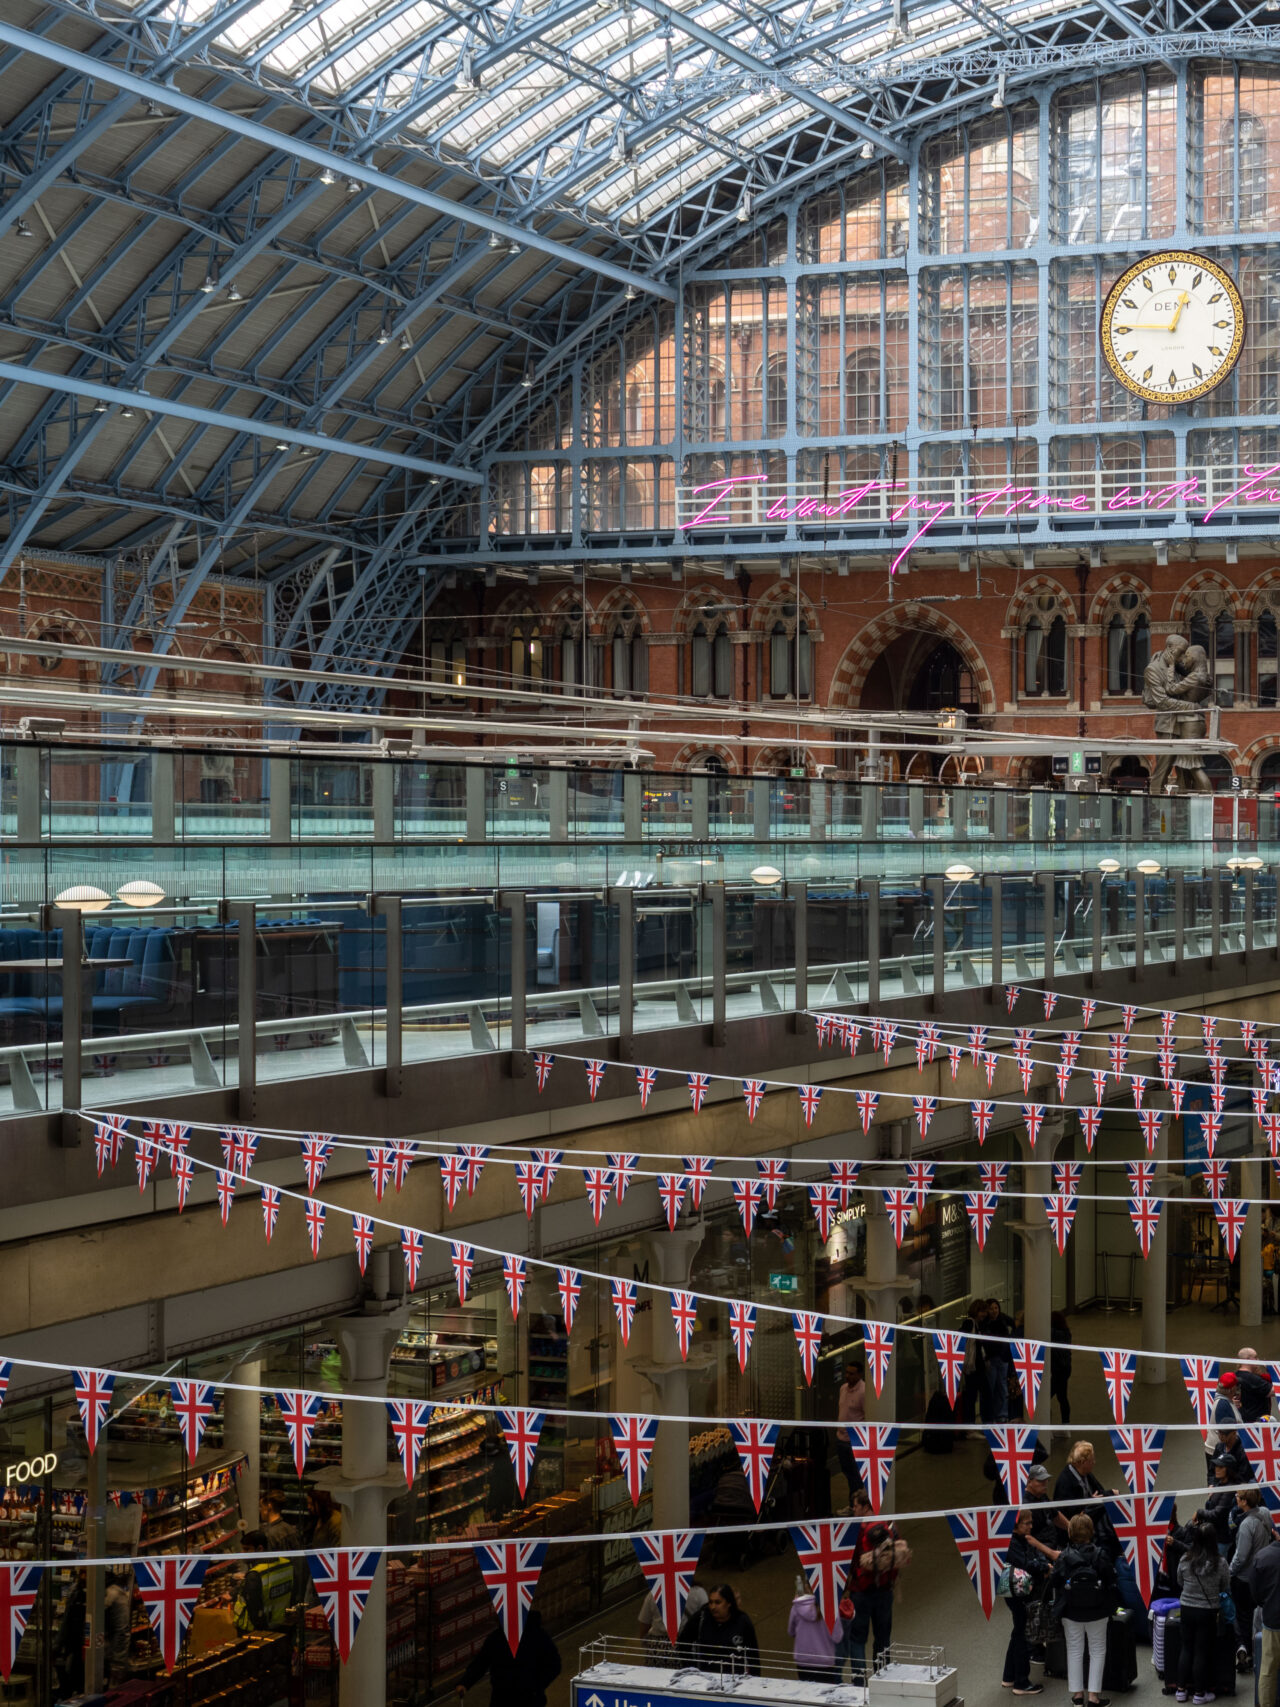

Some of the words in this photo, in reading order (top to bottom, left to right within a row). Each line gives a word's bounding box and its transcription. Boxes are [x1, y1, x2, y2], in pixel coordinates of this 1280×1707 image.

[678, 475, 768, 531] I
[500, 781, 507, 791] S
[1231, 777, 1240, 787] S
[6, 1453, 58, 1487] FOOD
